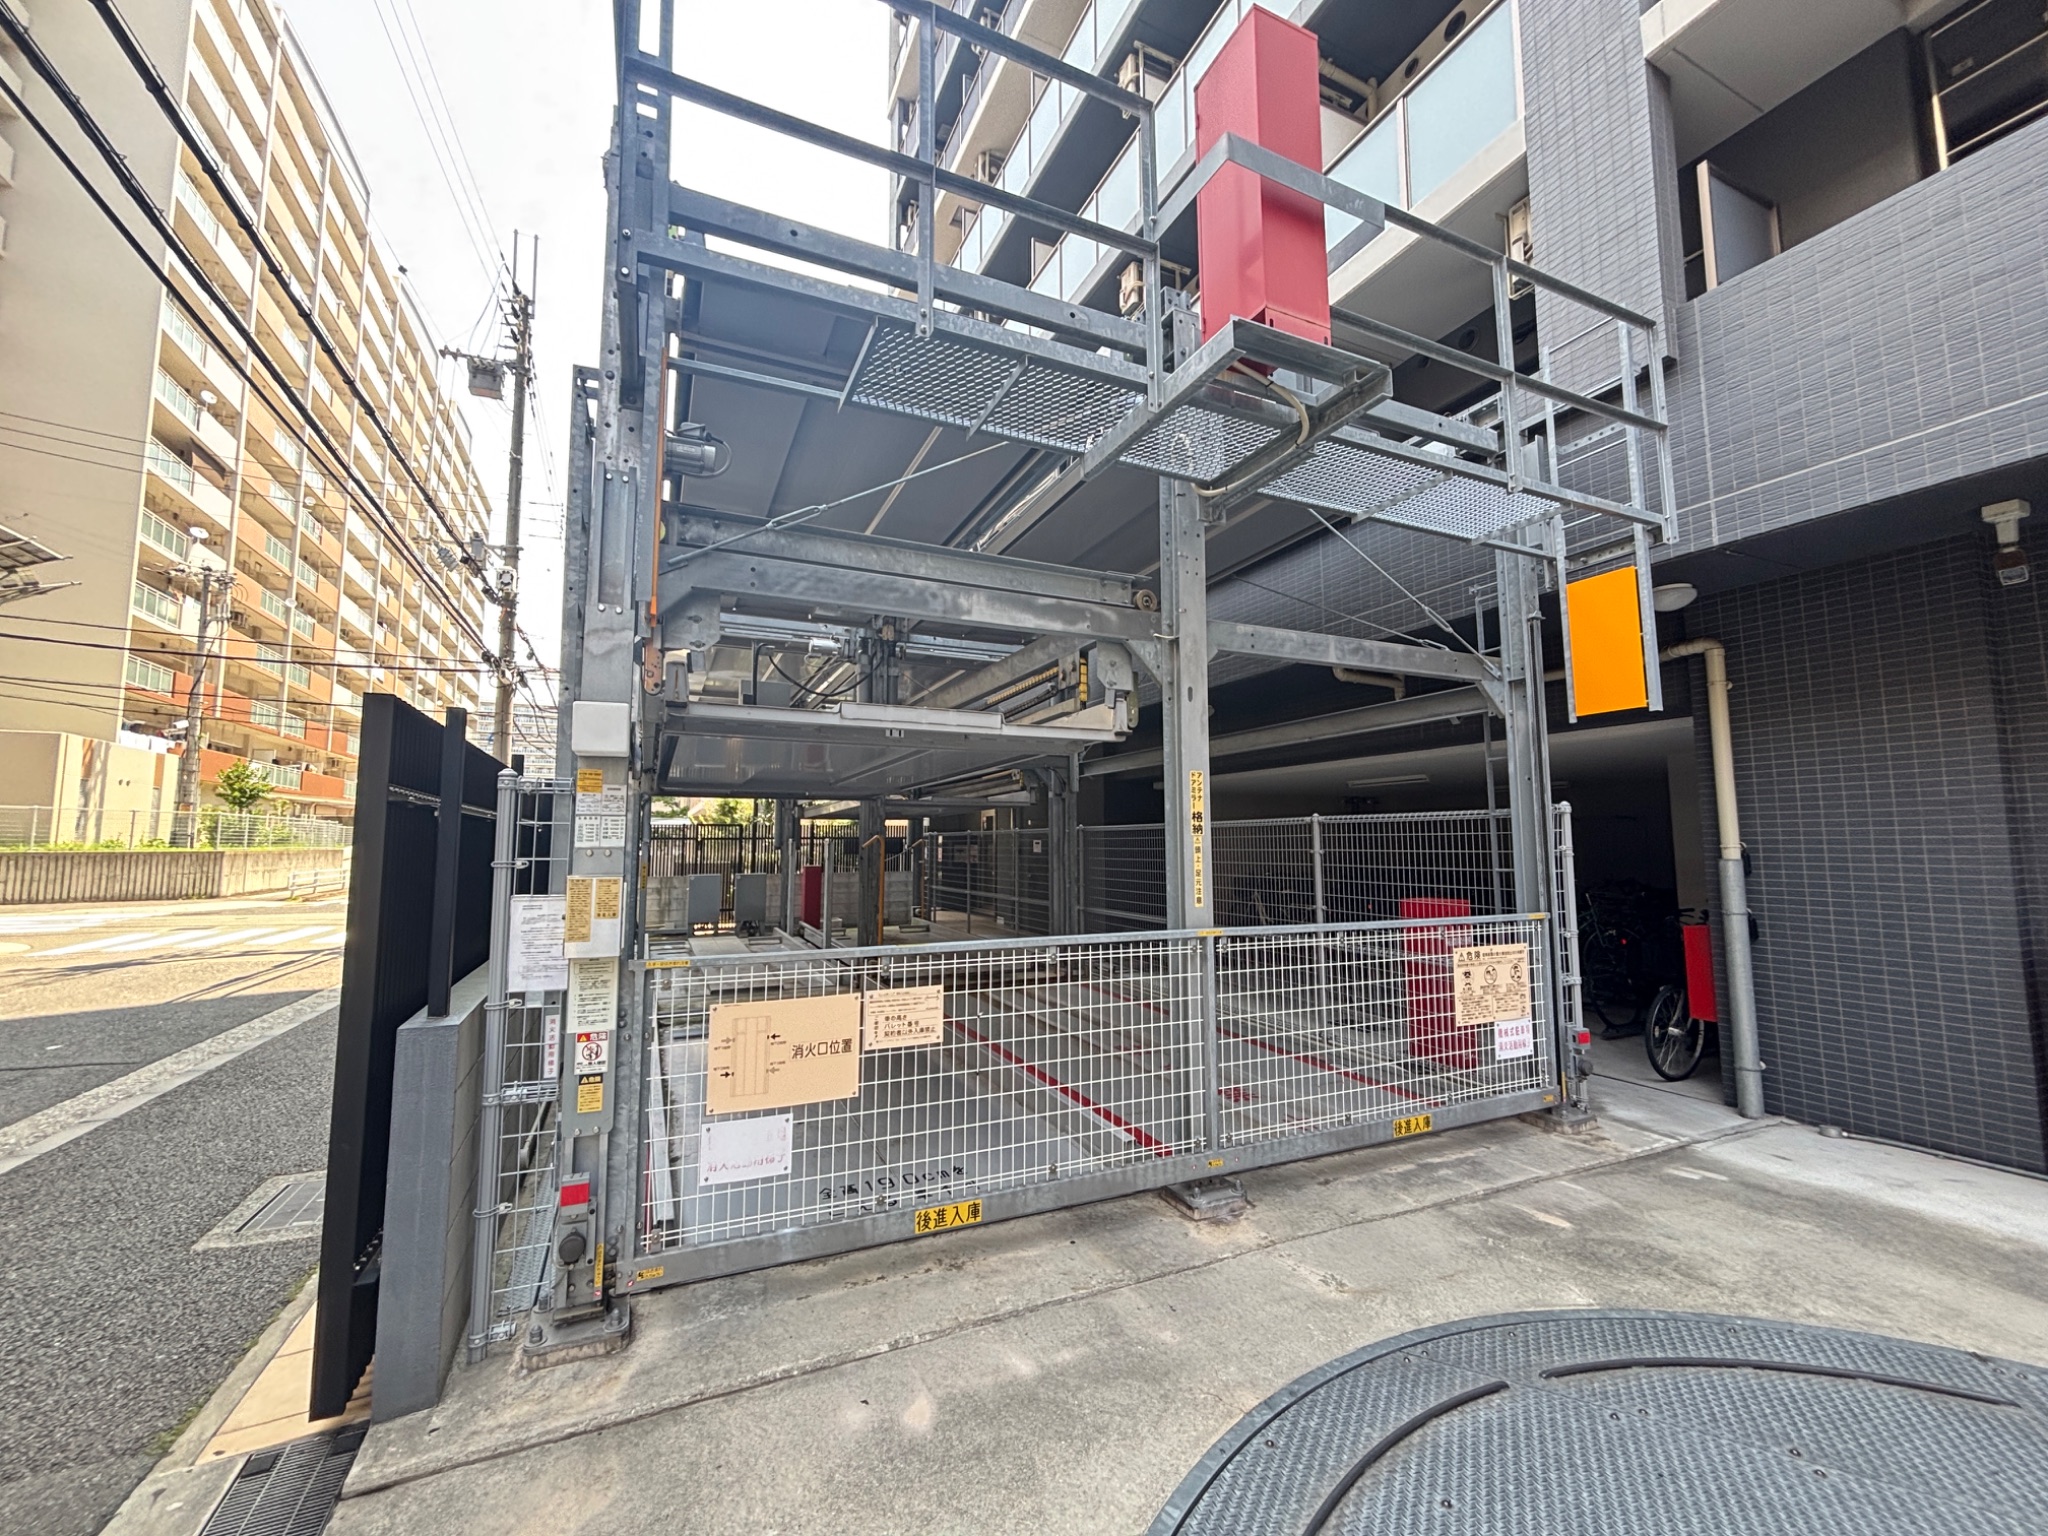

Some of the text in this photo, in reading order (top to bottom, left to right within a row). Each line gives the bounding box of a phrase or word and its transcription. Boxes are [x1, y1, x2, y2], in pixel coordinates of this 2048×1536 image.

[1191, 810, 1204, 835] 格納
[1466, 951, 1482, 961] 危険
[884, 1020, 920, 1030] パレット番号
[791, 1038, 853, 1060] 消火口位置
[1394, 1114, 1432, 1137] 後進入庫
[915, 1201, 982, 1233] 後進入庫
